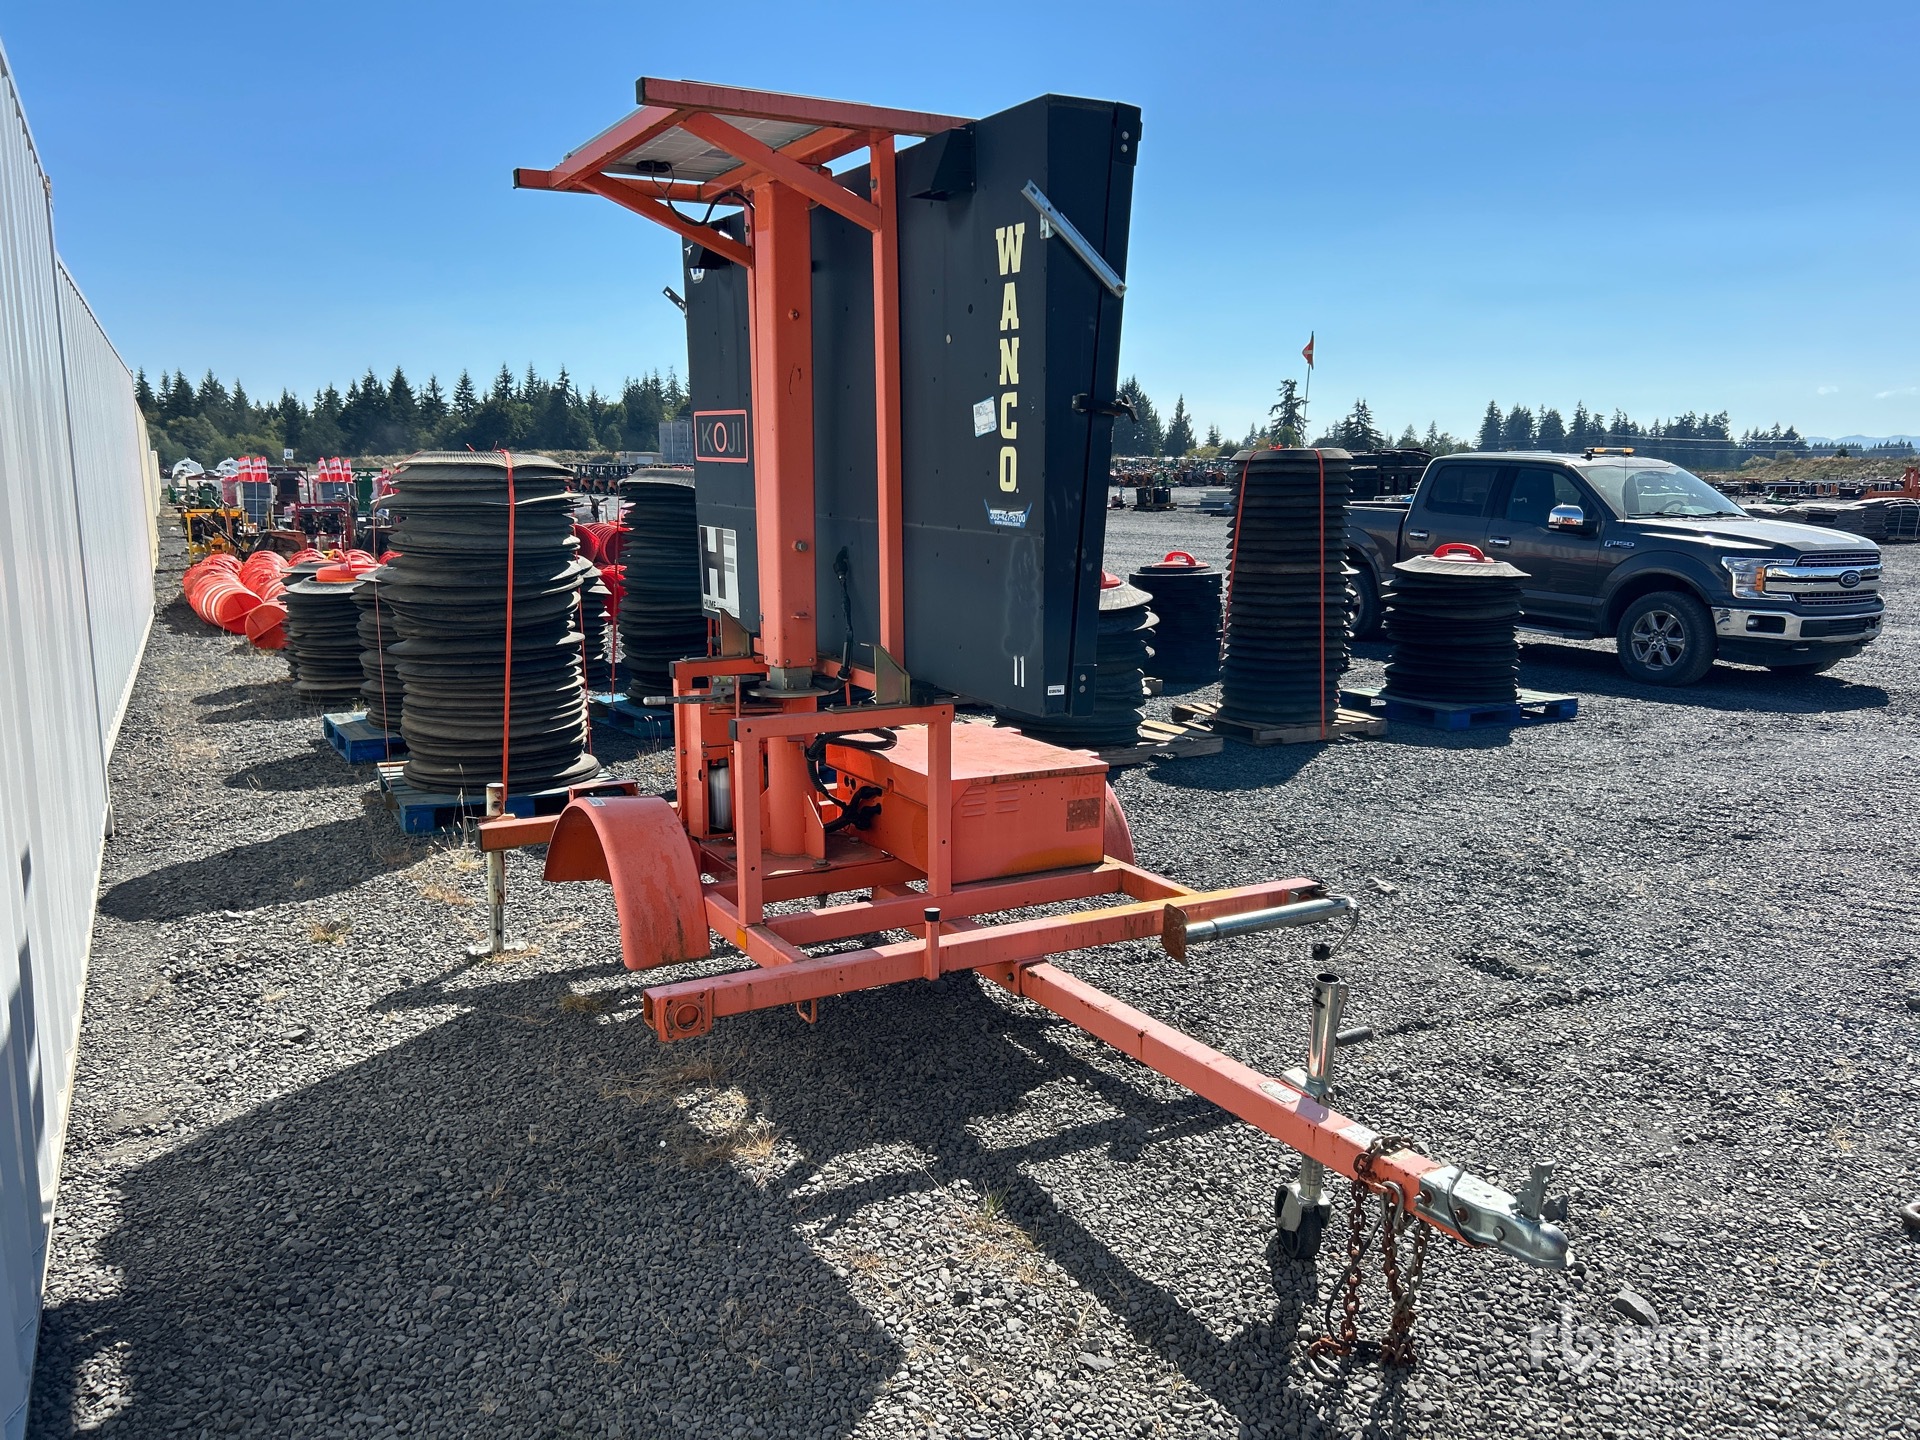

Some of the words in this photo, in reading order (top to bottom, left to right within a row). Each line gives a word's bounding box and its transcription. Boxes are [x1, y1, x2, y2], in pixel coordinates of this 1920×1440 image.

[995, 222, 1025, 492] WANCO
[701, 422, 741, 453] KOJI
[1013, 655, 1025, 688] 11
